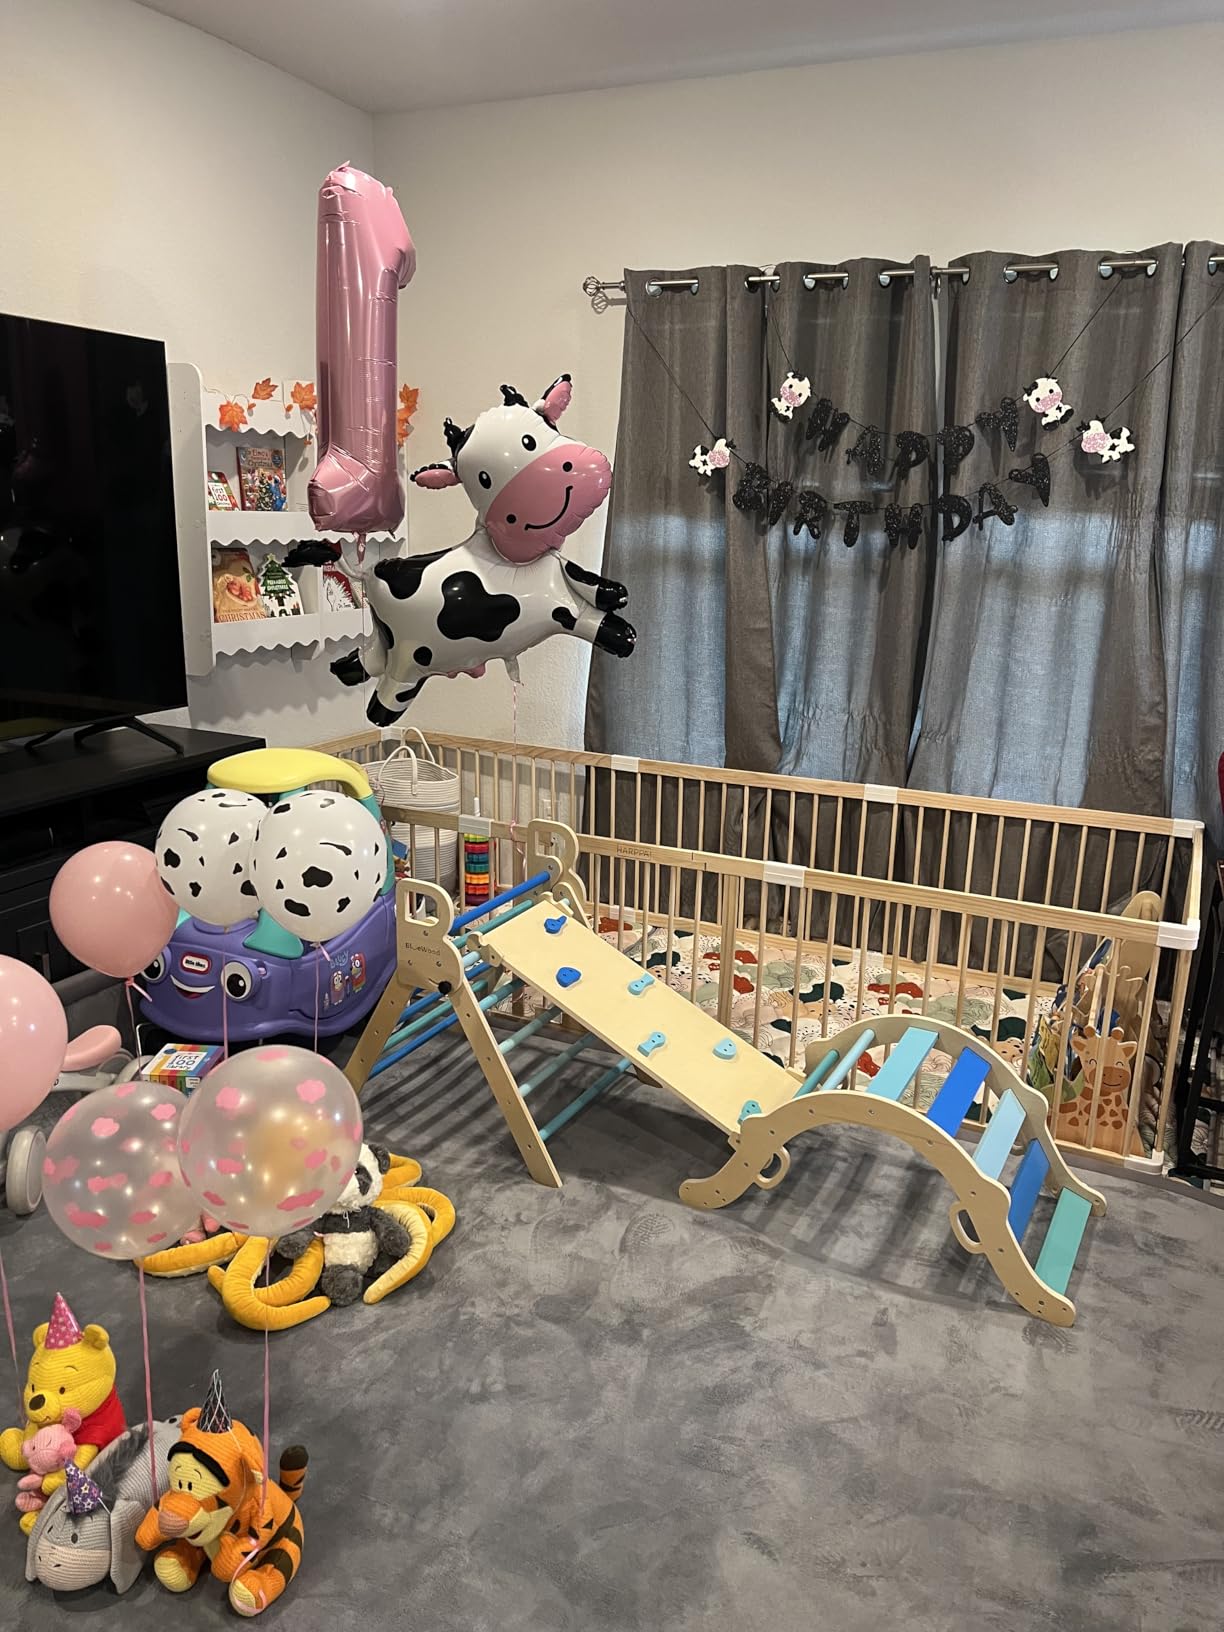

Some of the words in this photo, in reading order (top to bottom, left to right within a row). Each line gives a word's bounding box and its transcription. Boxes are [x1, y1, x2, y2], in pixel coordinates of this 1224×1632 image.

[805, 397, 1018, 480] HAPPY
[732, 453, 1050, 550] BIRTHDAY
[219, 611, 267, 622] CHRISTMAS
